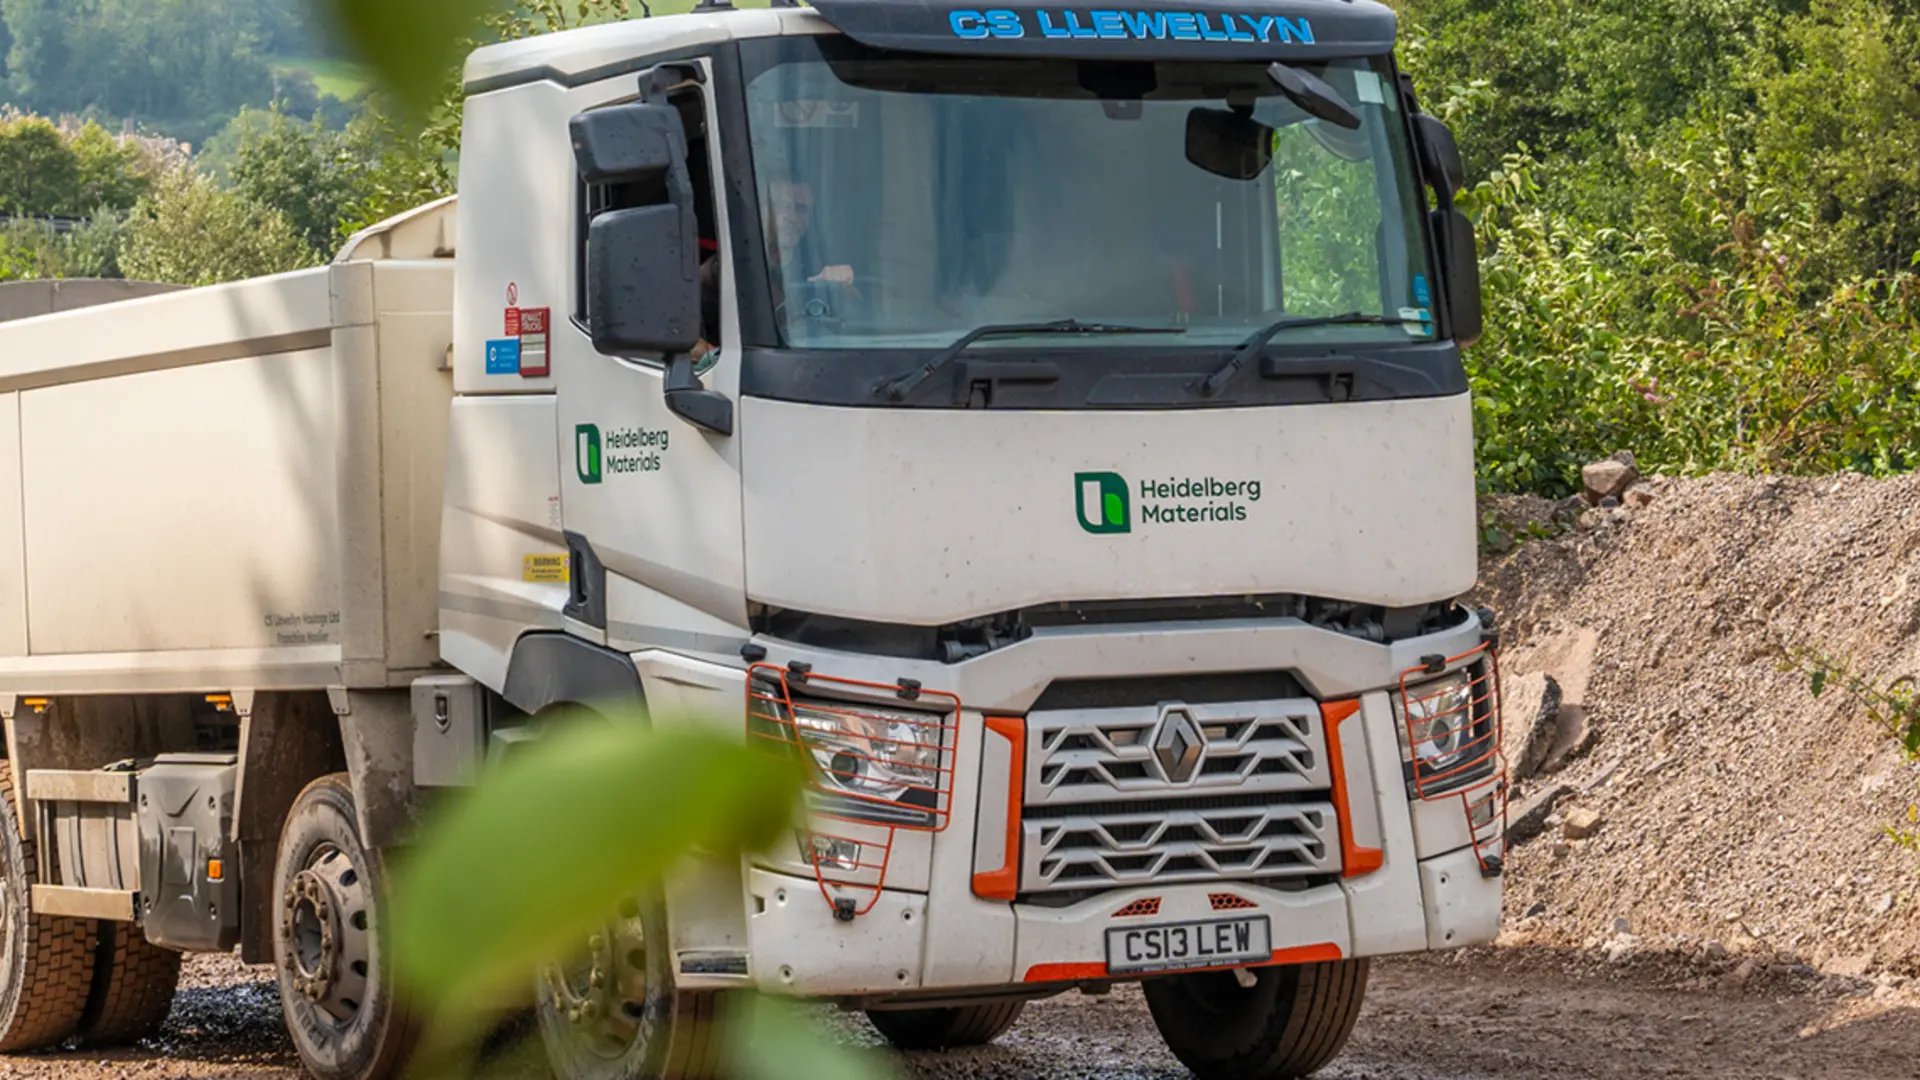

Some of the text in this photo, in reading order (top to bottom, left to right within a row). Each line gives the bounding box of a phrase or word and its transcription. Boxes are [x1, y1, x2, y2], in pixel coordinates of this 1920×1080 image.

[949, 10, 1315, 44] CS LLEWELLYN
[606, 427, 669, 451] Heidelberg
[607, 451, 660, 474] Materials
[1141, 477, 1261, 501] Heidelberg
[1142, 501, 1247, 524] Materials
[533, 557, 561, 566] WARNING
[265, 610, 340, 628] CS Llewellyn Haulage Ltd
[1126, 922, 1250, 961] CS13 LEW
